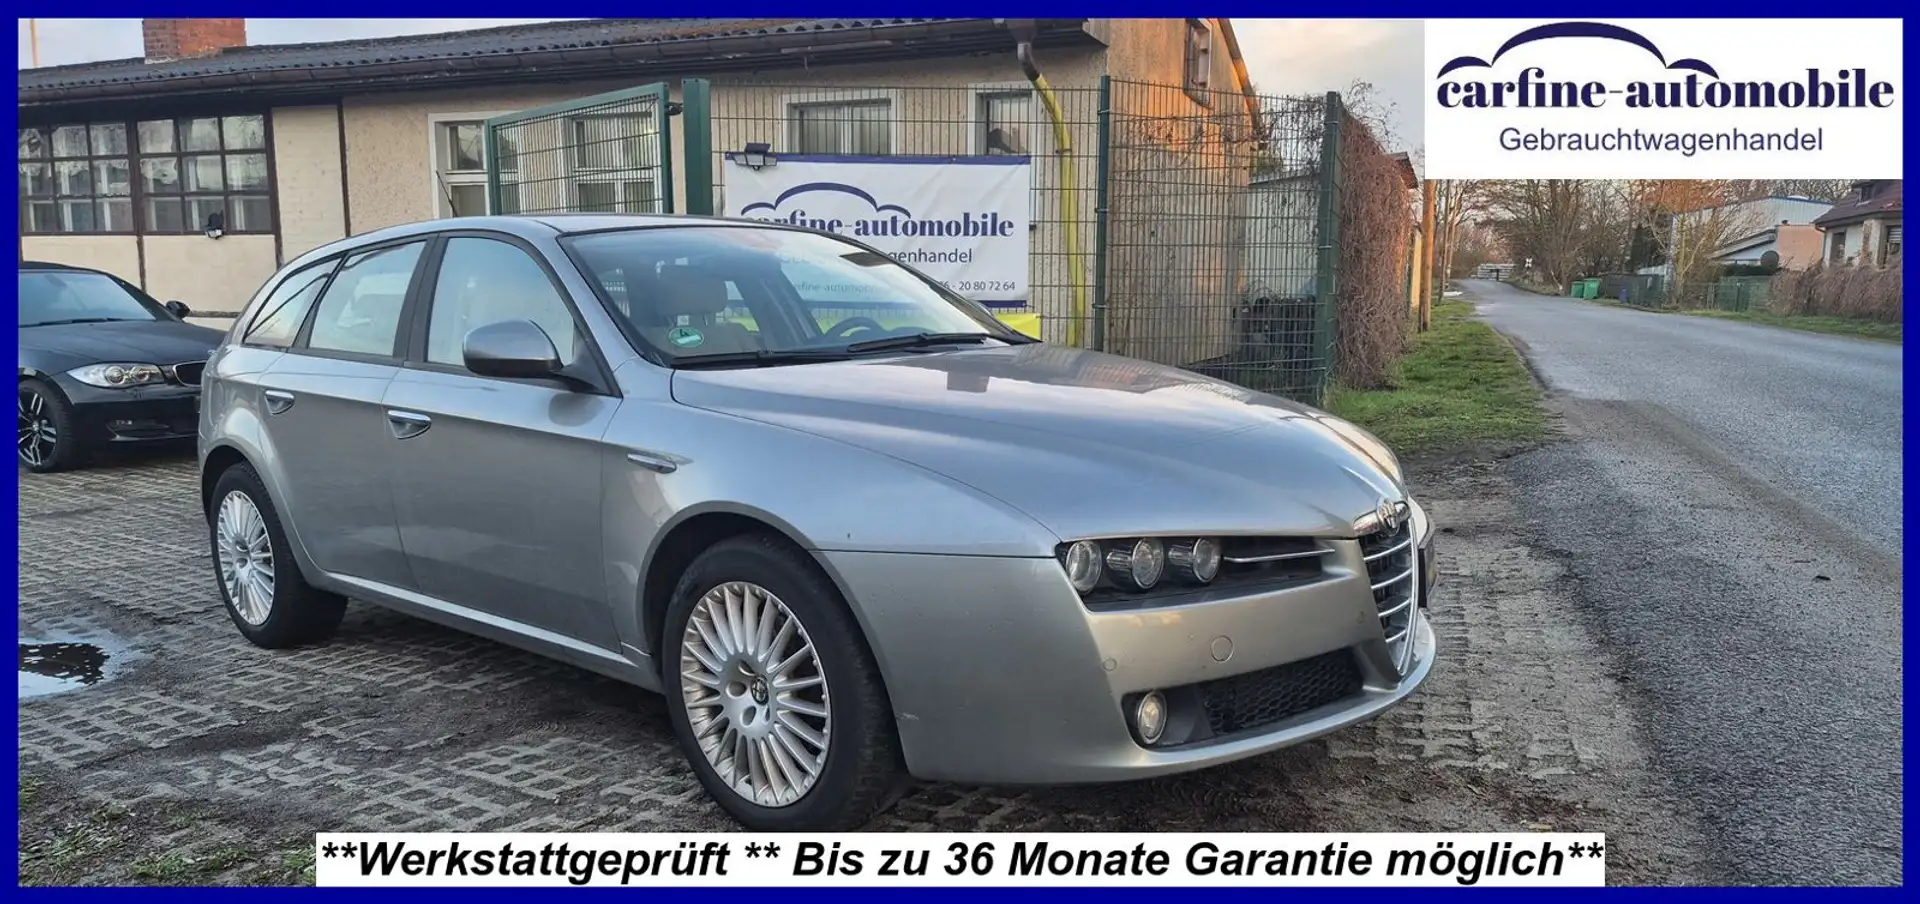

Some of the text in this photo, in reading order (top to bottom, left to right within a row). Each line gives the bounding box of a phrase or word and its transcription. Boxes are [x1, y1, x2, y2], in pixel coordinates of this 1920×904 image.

[752, 209, 1014, 237] fine-automobile
[959, 281, 971, 291] 20
[973, 281, 986, 291] 80
[988, 281, 1001, 291] 72
[1003, 281, 1016, 291] 64
